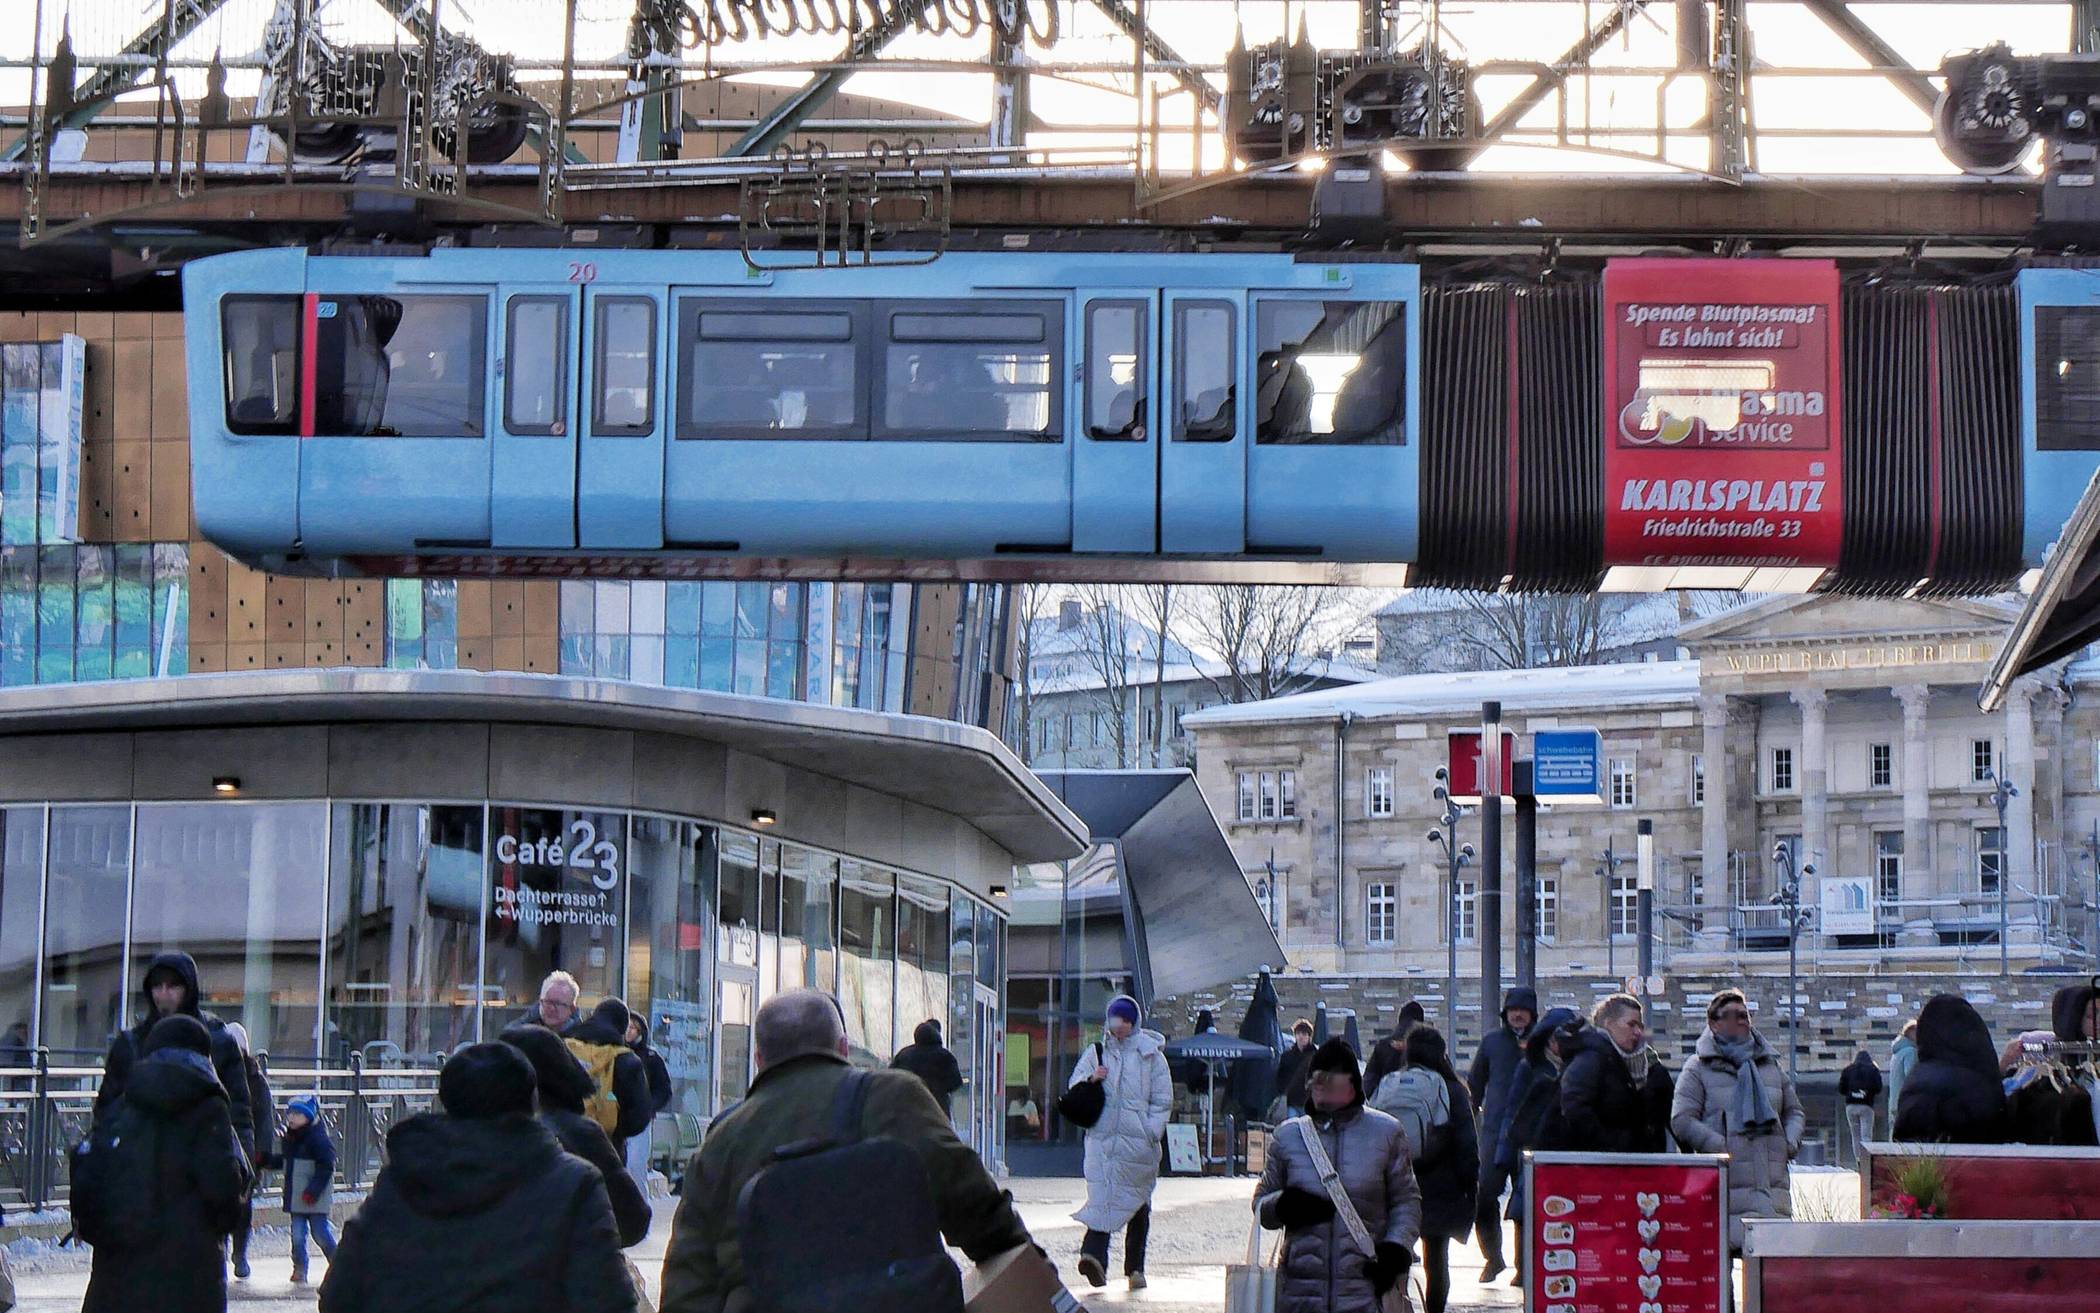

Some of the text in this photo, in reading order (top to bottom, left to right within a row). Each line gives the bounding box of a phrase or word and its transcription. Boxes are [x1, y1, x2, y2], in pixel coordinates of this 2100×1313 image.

[569, 262, 595, 283] 20
[1626, 304, 1816, 327] Spende Blutplasma!
[1658, 327, 1784, 348] Es lohnt sich!
[1620, 479, 1826, 513] KARLSPLATZ
[1642, 517, 1802, 538] Friedrichstraße 33
[496, 819, 618, 890] Café 23
[495, 886, 597, 908] Dachterrasse
[510, 904, 618, 927] Wupperbrücke
[1181, 1047, 1243, 1058] STARBUCKS
